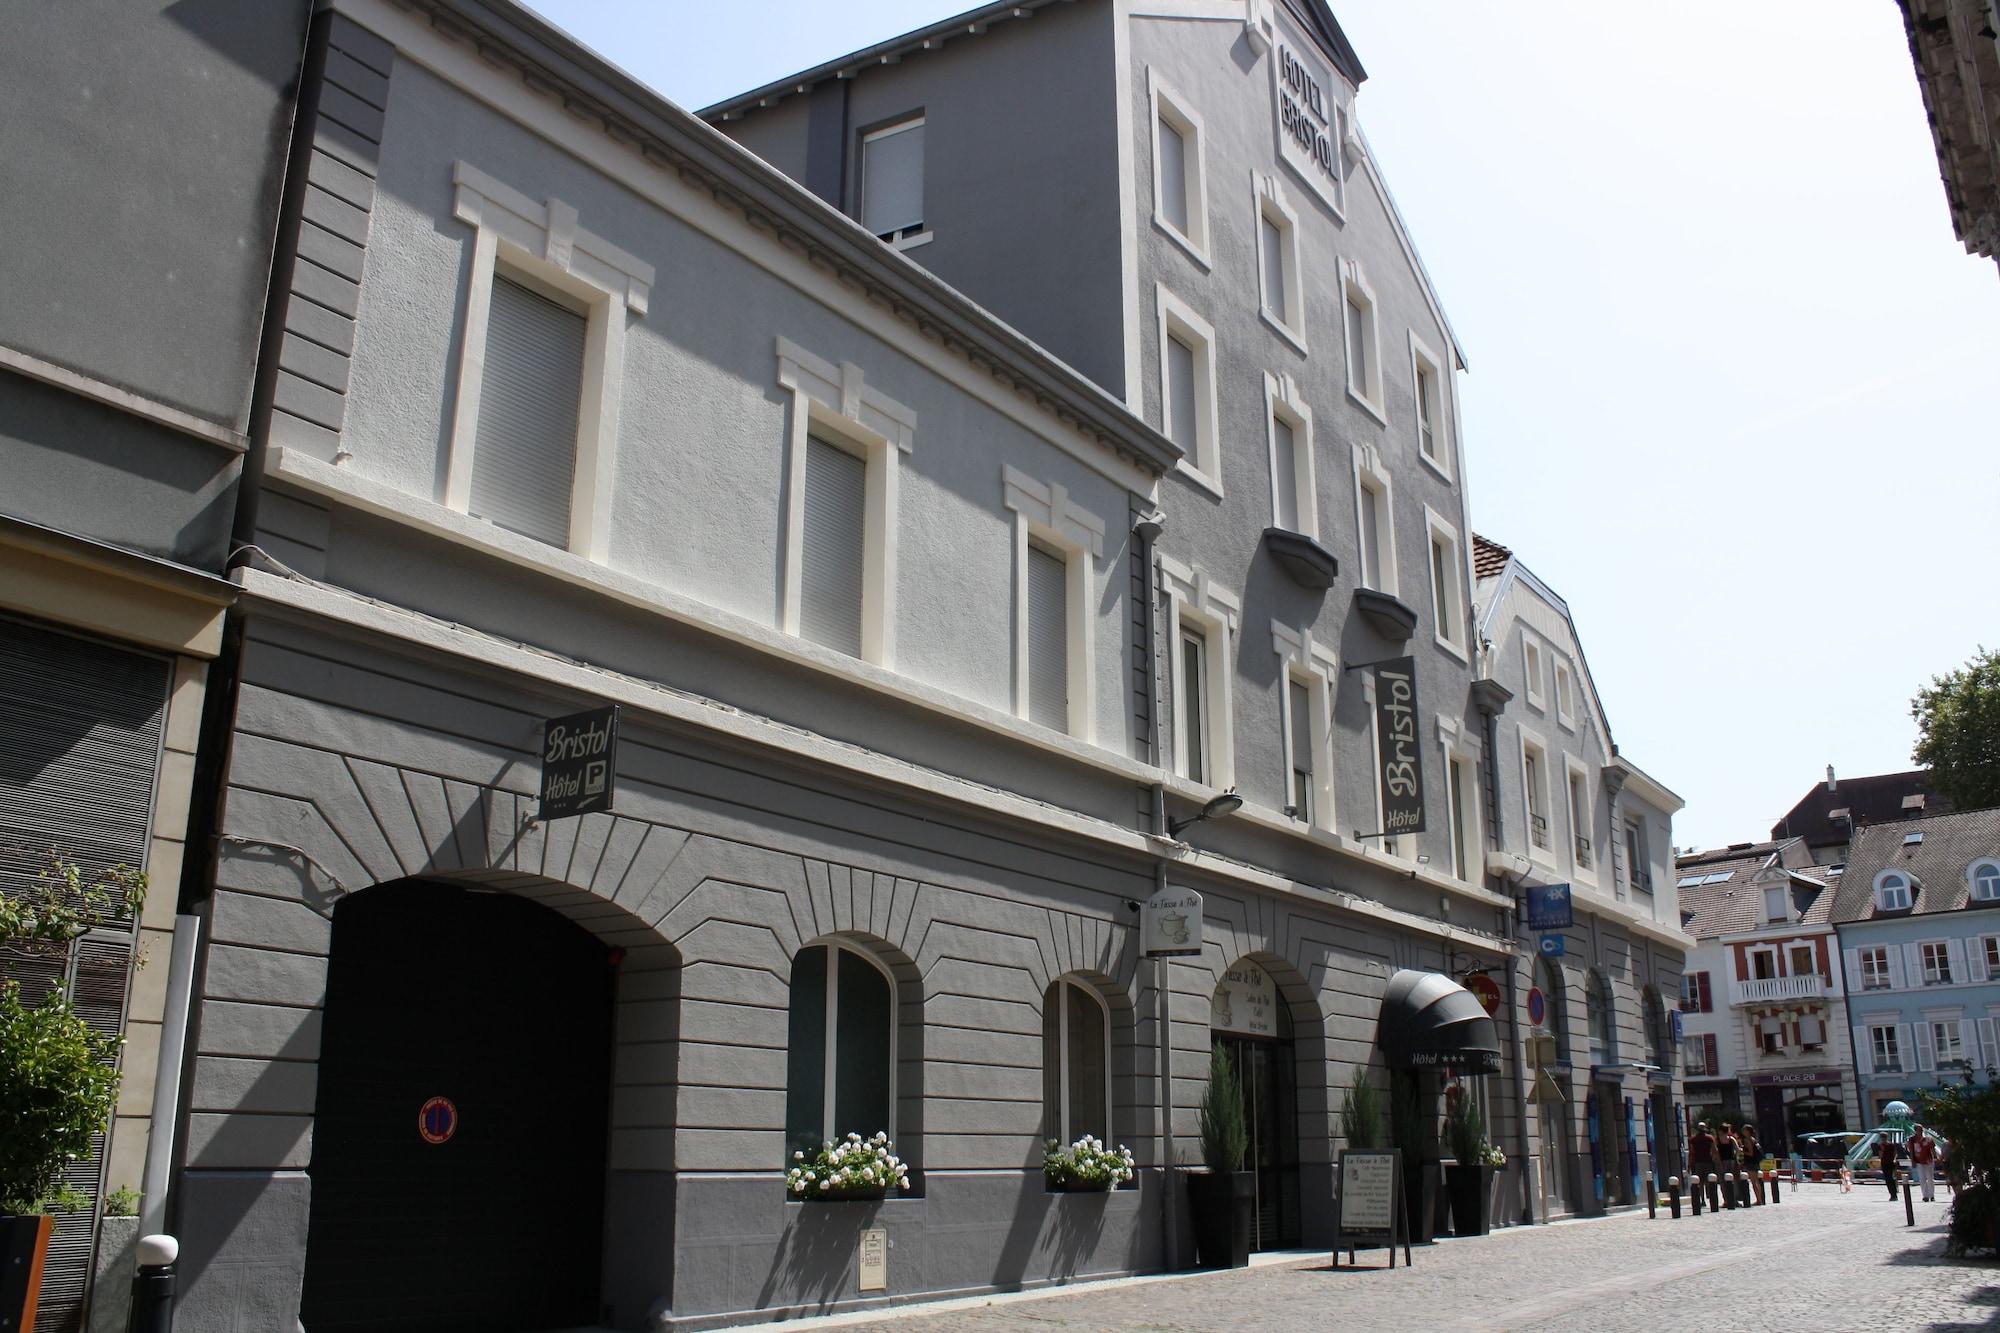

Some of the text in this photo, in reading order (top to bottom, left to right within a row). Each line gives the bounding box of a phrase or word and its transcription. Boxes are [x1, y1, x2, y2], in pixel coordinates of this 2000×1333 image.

[1279, 44, 1328, 126] HOTEL
[1279, 87, 1338, 181] BRISTOL
[545, 714, 613, 763] Bristol
[1380, 670, 1417, 797] Bristol
[545, 769, 582, 802] Hôtel
[1387, 807, 1421, 828] Hôtel
[1772, 1074, 1801, 1082] PLACE
